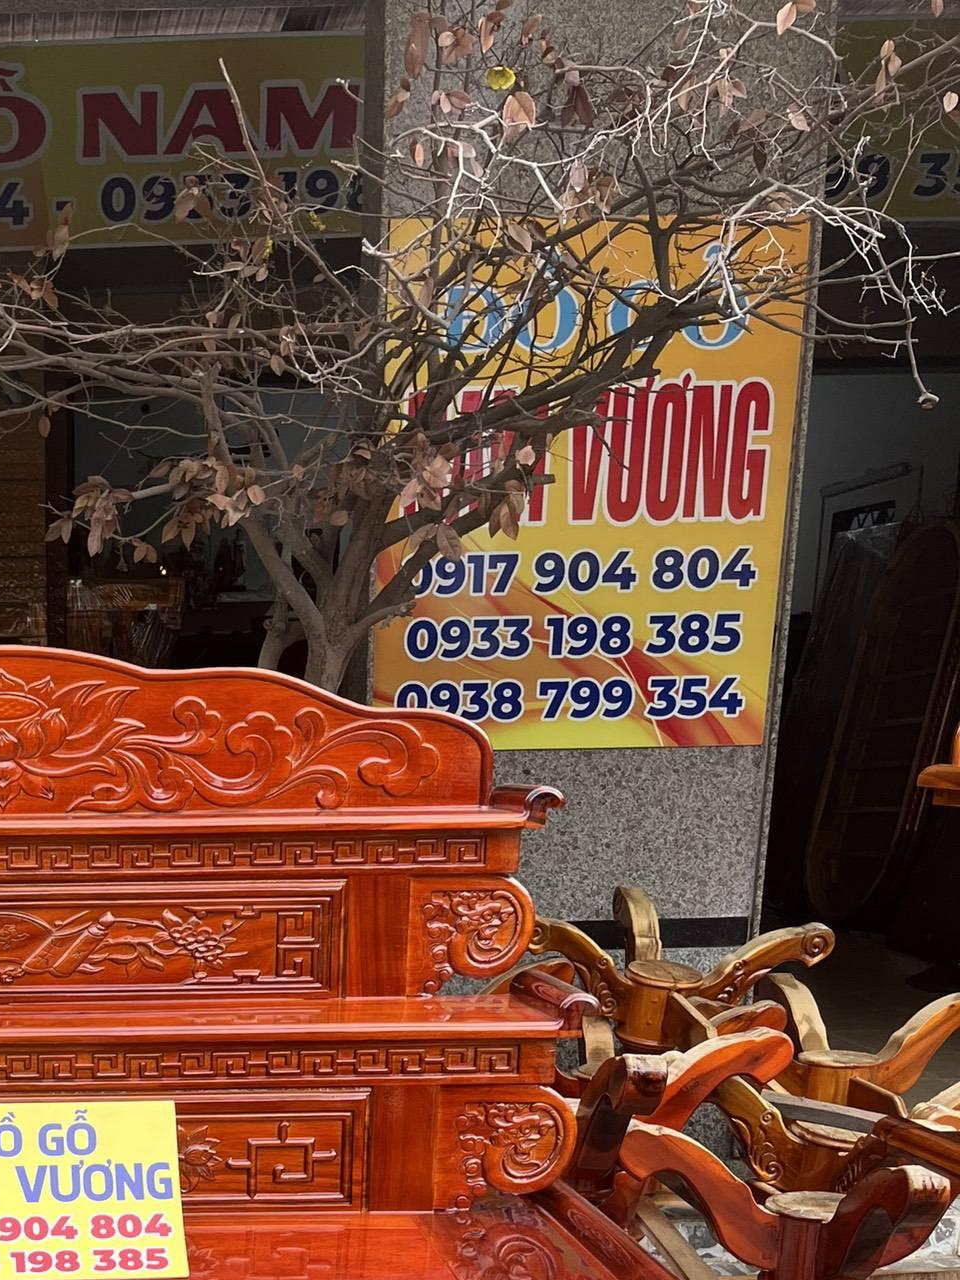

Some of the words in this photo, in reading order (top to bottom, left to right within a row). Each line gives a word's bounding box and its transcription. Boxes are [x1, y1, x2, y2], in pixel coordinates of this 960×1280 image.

[80, 84, 361, 159] NAM
[570, 371, 772, 523] VƯƠNG
[533, 550, 638, 595] 904
[651, 547, 757, 592] 804
[405, 616, 533, 660] 0933
[545, 614, 632, 658] 198
[644, 612, 743, 656] 385
[395, 680, 523, 722] 0938
[540, 678, 634, 720] 799
[646, 676, 743, 719] 354
[38, 1108, 98, 1157] GỖ
[15, 1158, 174, 1204] VƯƠNG
[90, 1213, 173, 1240] 804
[10, 1249, 81, 1274] 198
[93, 1247, 170, 1272] 385
